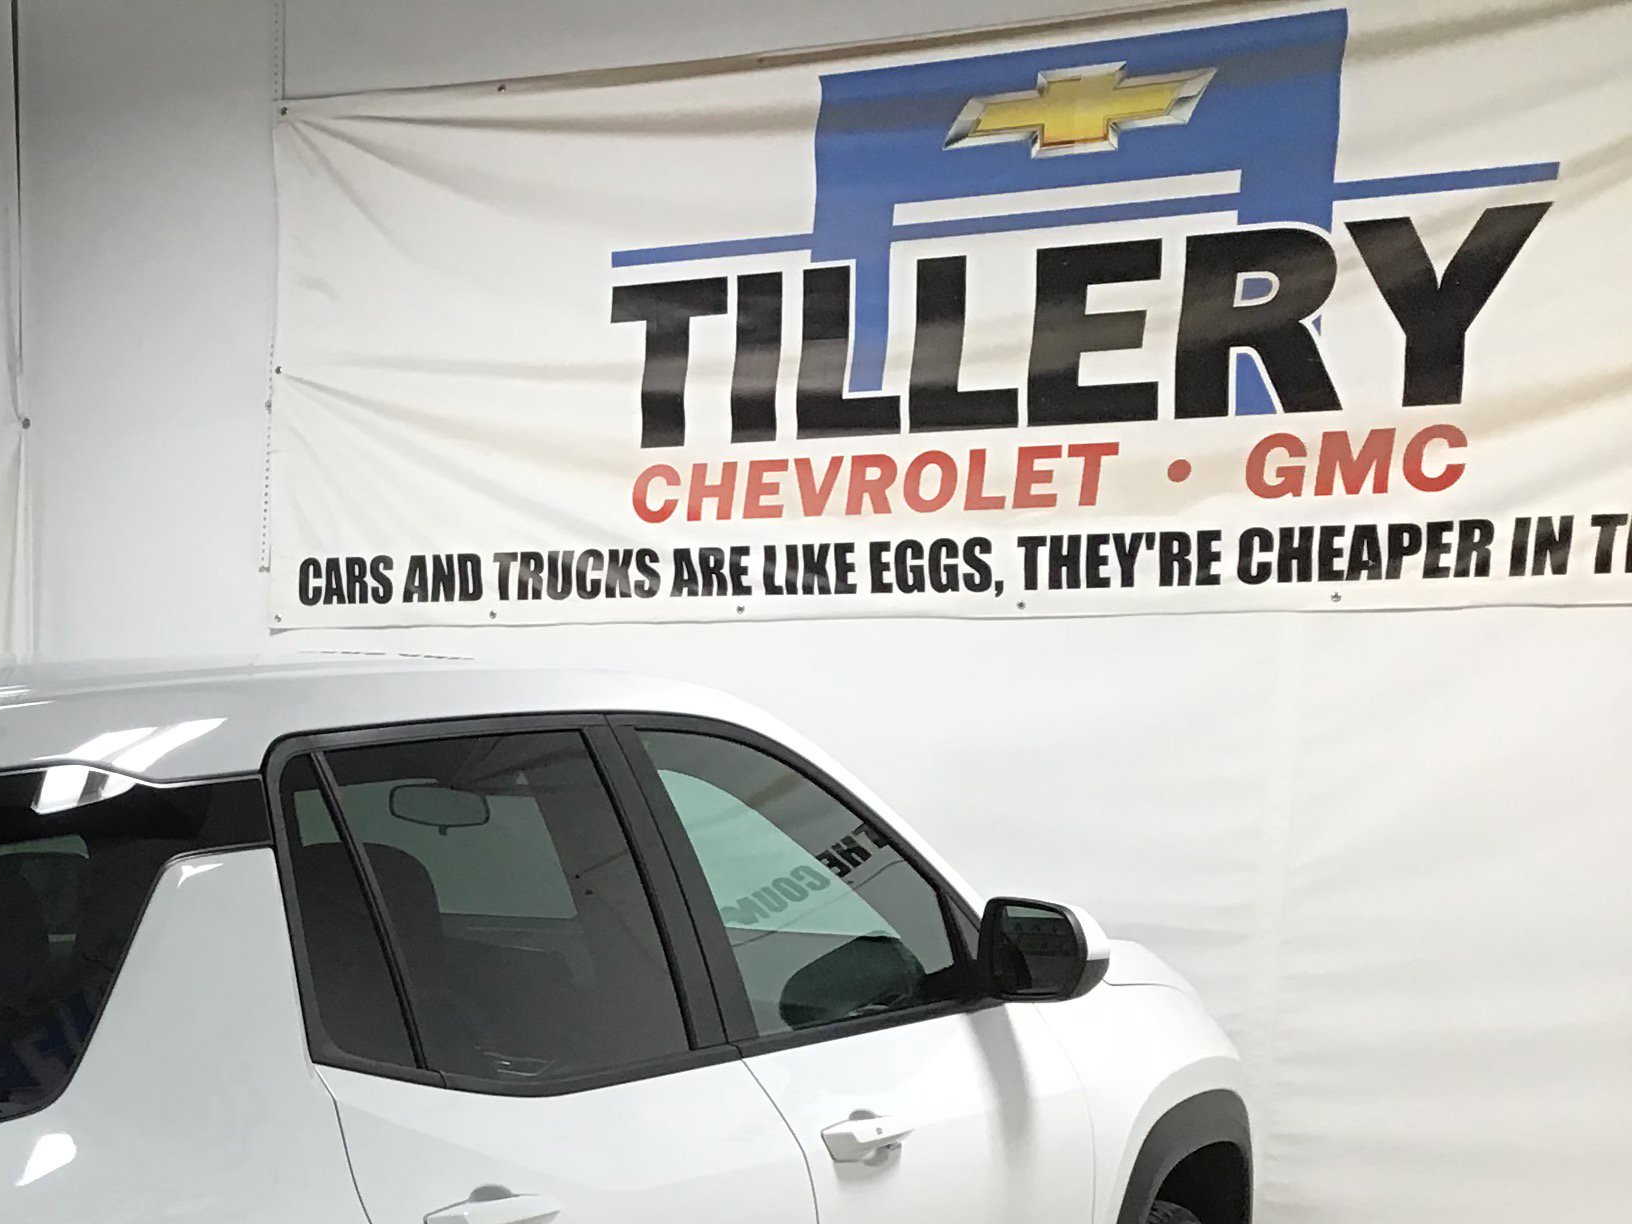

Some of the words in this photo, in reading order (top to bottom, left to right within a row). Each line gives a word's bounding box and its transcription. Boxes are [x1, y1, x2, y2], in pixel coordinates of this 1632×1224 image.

[611, 202, 1553, 448] TILLERY
[632, 443, 1119, 523] CHEVROLET
[1246, 424, 1467, 499] GMC
[299, 555, 393, 606] CARS
[402, 553, 483, 603] AND
[493, 548, 660, 601] TRUCKS
[670, 545, 752, 597] ARE
[763, 543, 857, 595] LIKE
[869, 538, 1003, 598] EGGS,
[1017, 529, 1221, 591] THEY'RE
[1236, 518, 1495, 583] CHEAPER
[1508, 515, 1574, 577] IN
